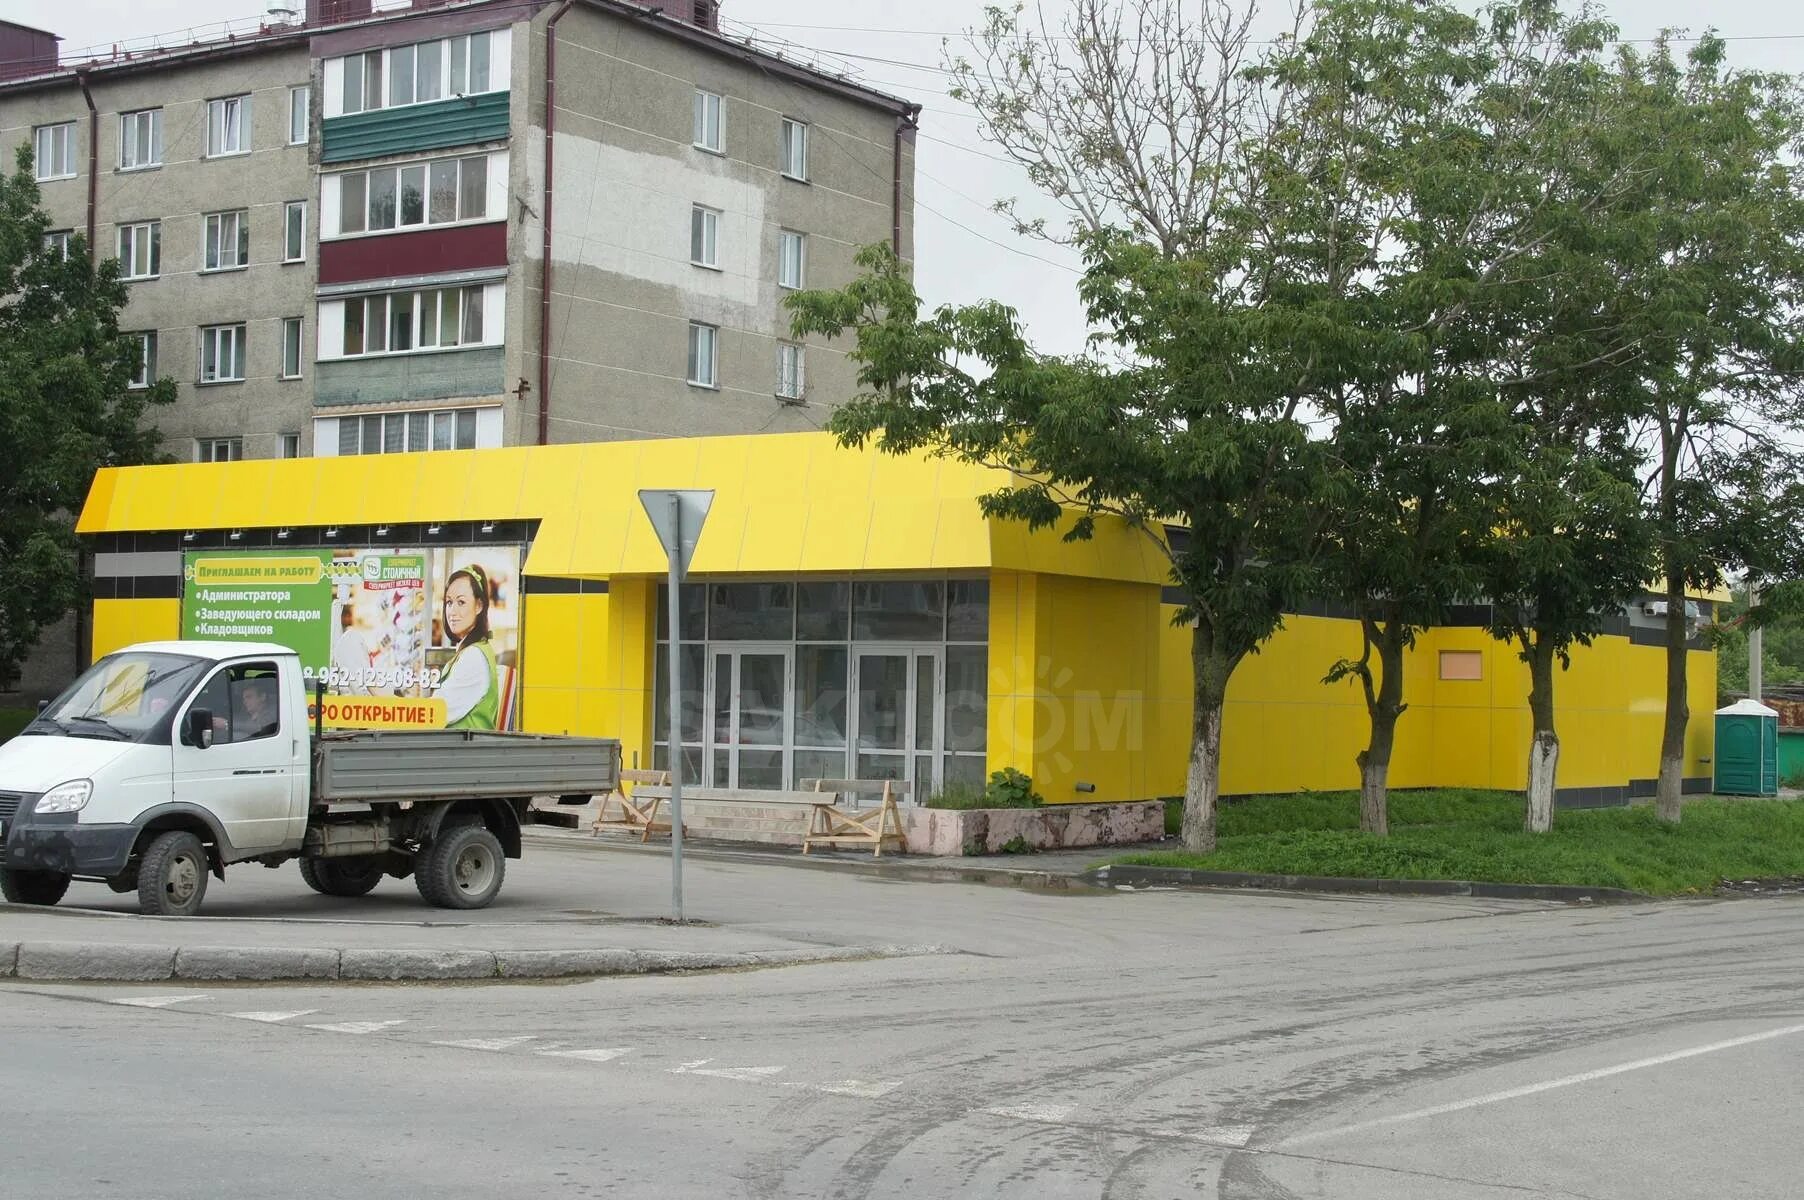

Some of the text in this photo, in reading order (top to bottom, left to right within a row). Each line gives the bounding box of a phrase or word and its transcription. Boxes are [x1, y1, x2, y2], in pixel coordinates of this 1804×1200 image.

[383, 565, 421, 579] СТОЛИЧНЫЙ
[202, 589, 290, 603] Администратора
[200, 607, 321, 622] Заведующего складом
[200, 623, 273, 637] Кладовщиков
